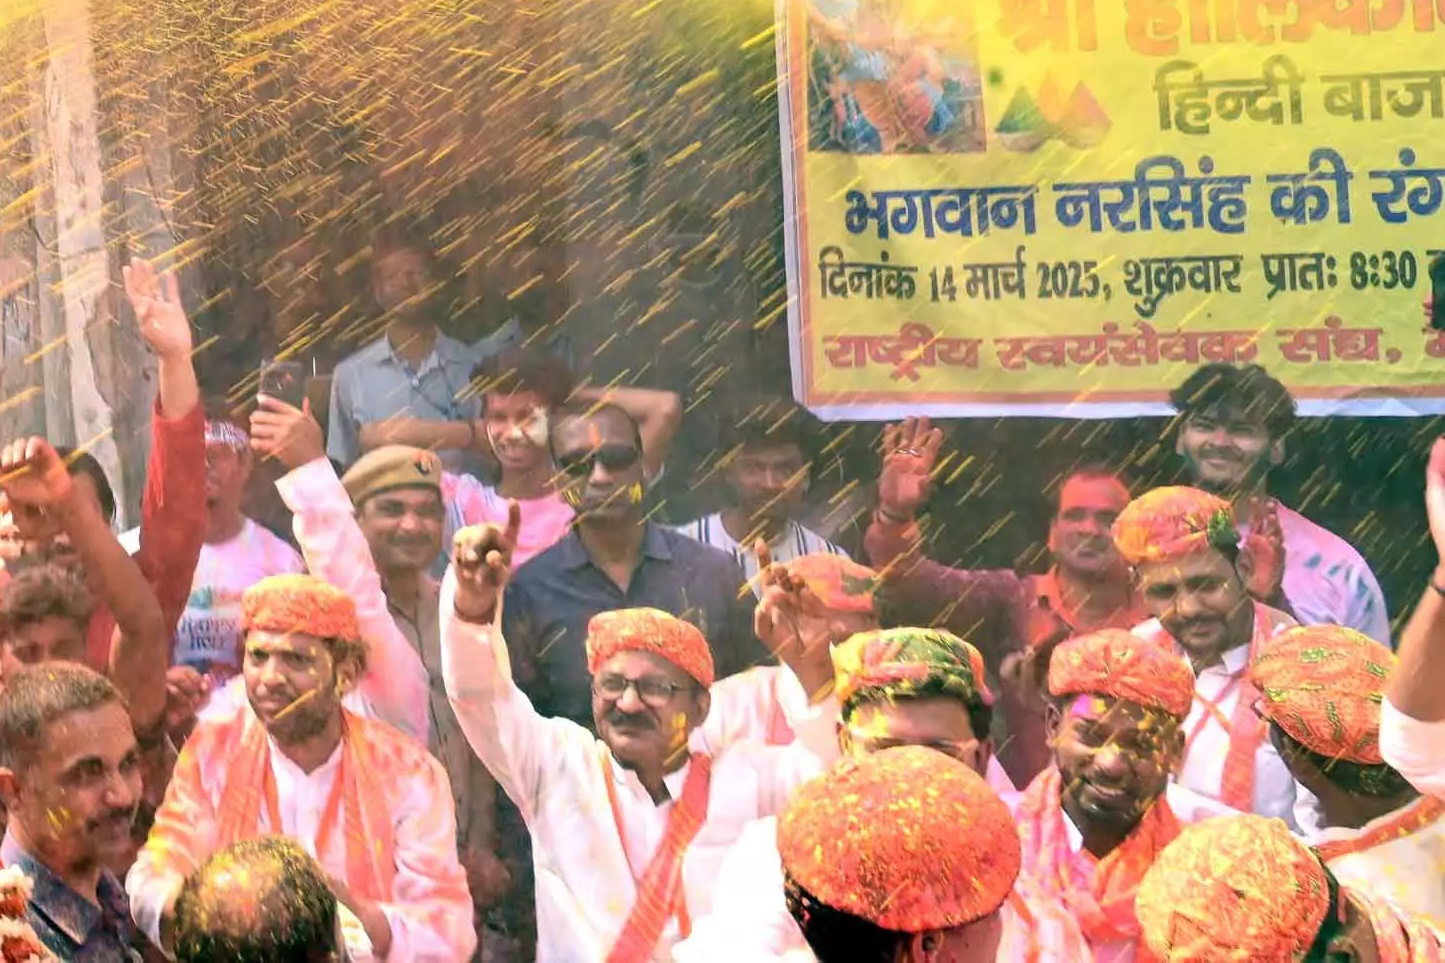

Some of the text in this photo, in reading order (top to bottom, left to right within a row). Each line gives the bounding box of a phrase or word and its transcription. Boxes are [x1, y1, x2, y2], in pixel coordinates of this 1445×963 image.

[1153, 54, 1305, 135] हिन्दी
[844, 184, 1039, 240] भगवान
[1052, 155, 1252, 235] नरसिंह
[1266, 147, 1354, 225] की
[818, 245, 918, 300] दिनांक
[929, 263, 957, 302] 14
[963, 245, 1027, 301] मार्च
[1036, 260, 1112, 301] 2025,
[1124, 254, 1244, 318] शुक्रवार
[1350, 250, 1417, 290] 8:30
[823, 321, 984, 382] राष्ट्रीय
[994, 319, 1262, 372] स्वयंसेवक
